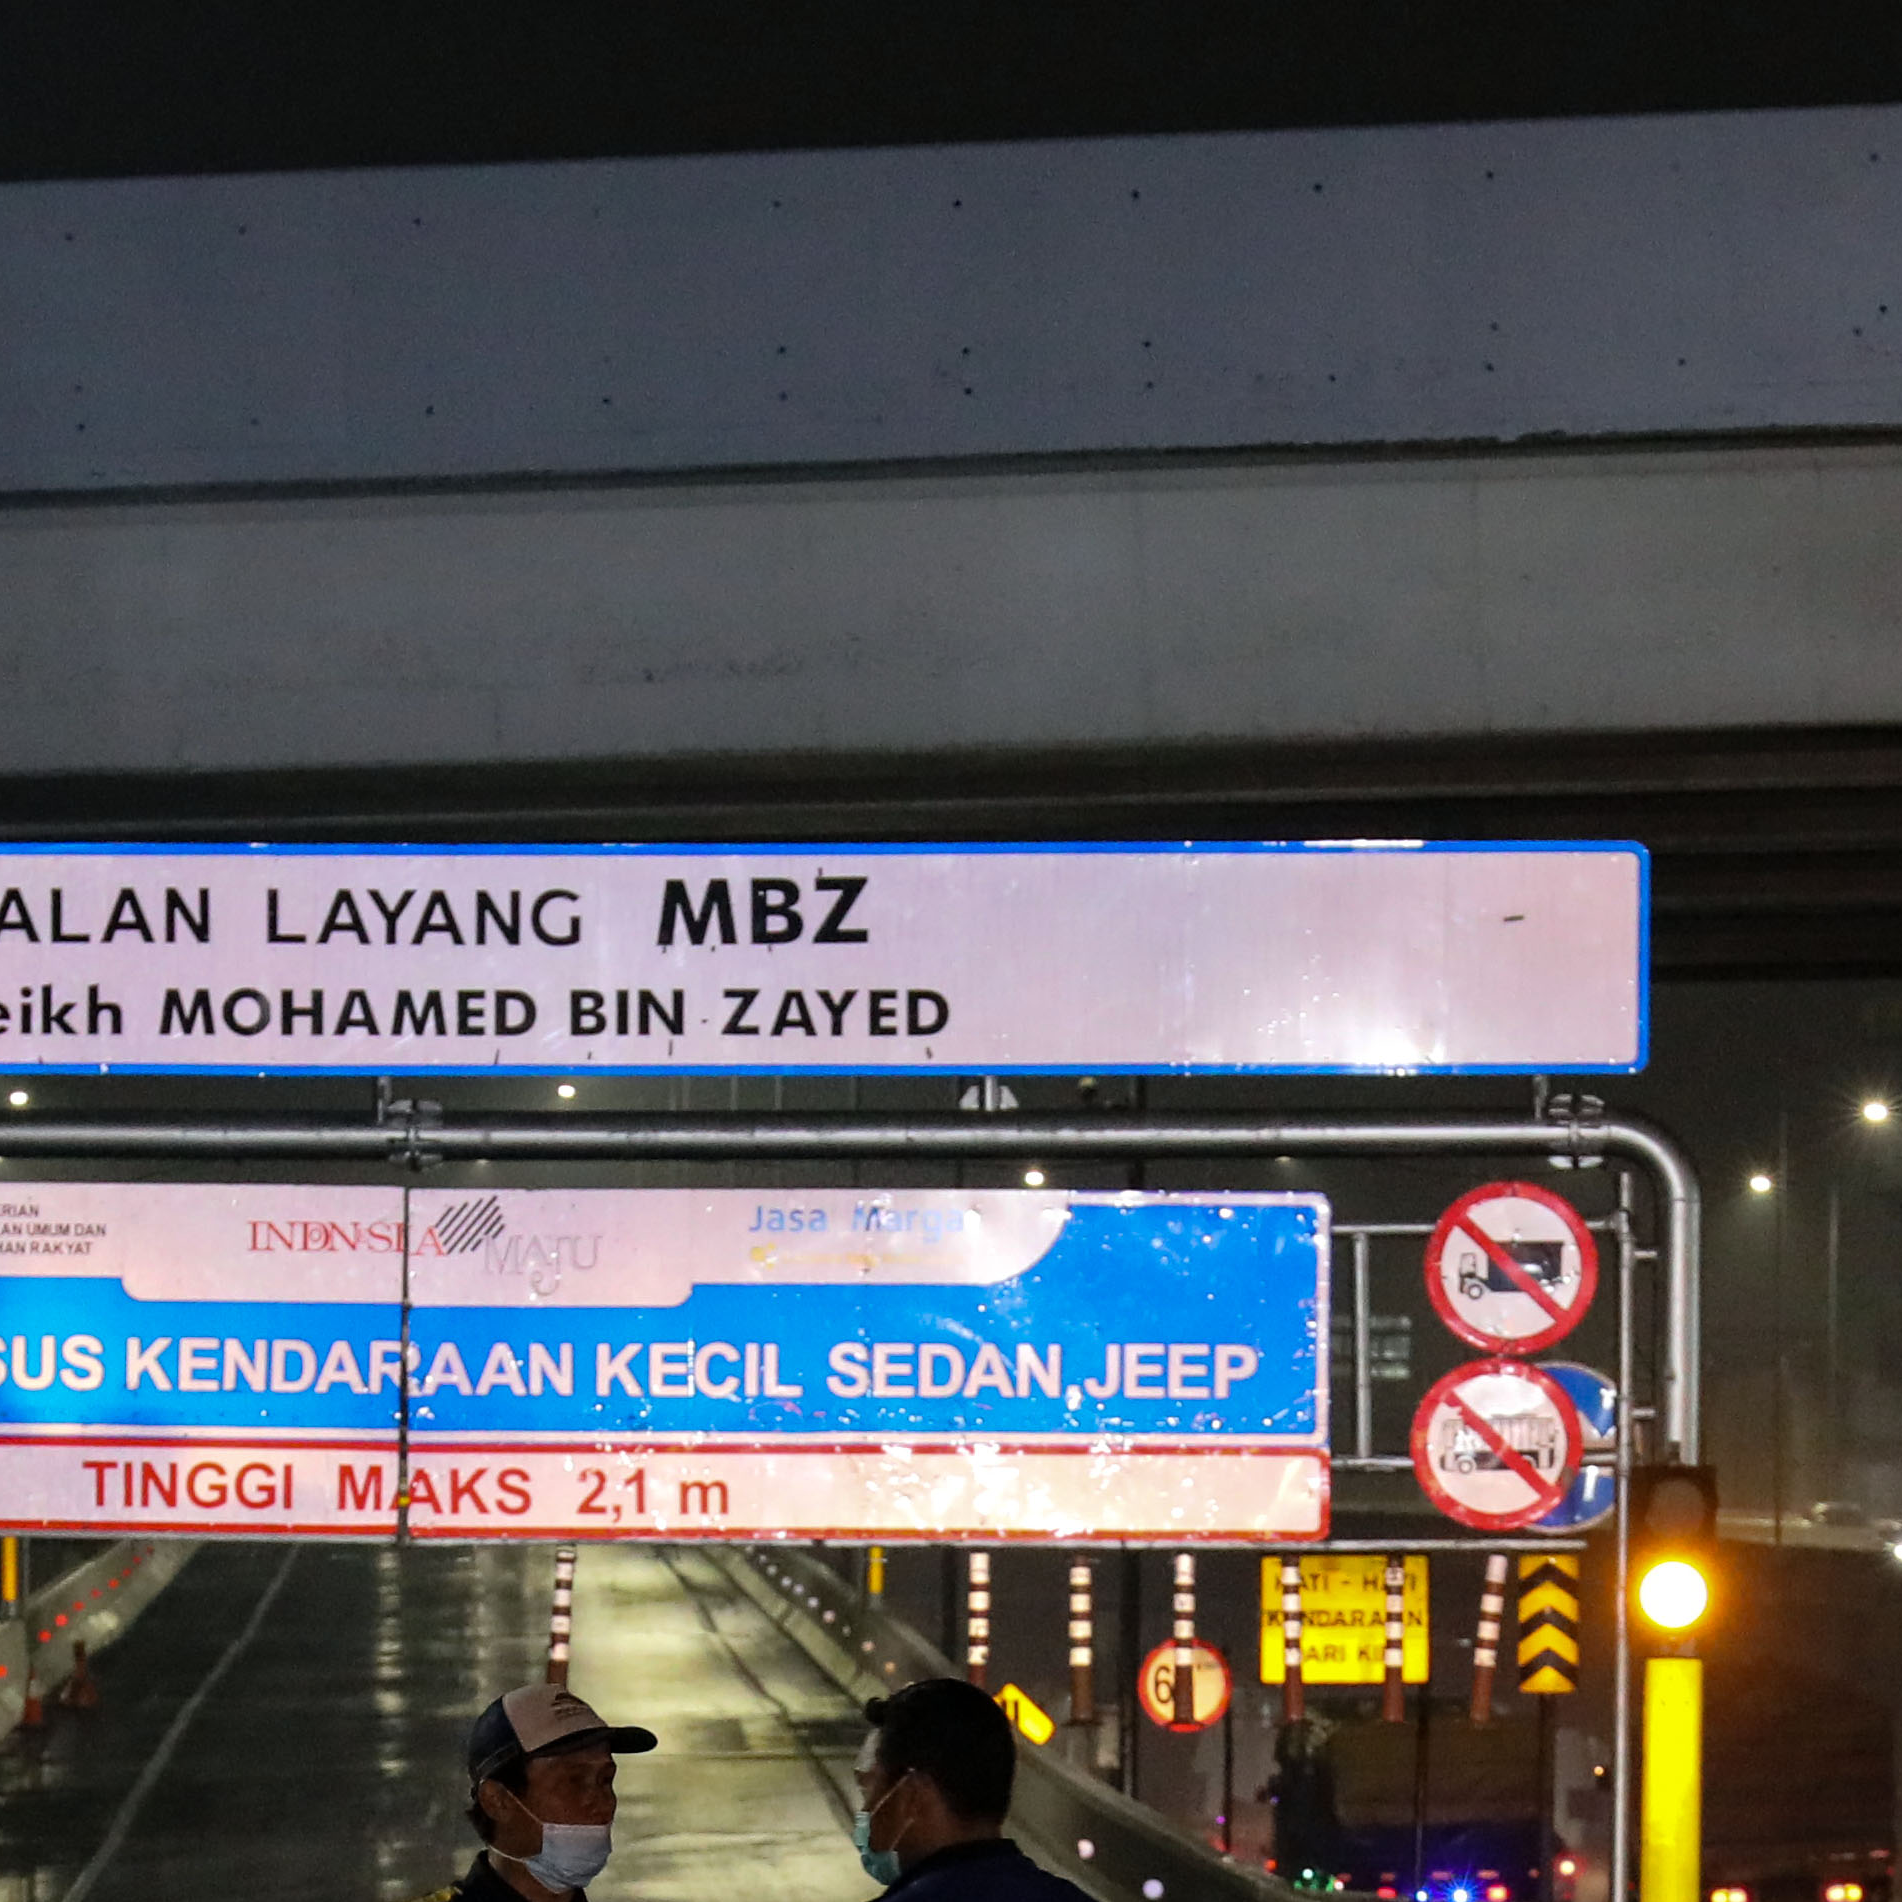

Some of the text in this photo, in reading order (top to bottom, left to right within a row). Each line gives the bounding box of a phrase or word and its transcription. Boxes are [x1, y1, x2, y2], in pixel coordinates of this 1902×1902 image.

[266, 888, 583, 947] LAYANG
[656, 878, 870, 947] MBZ
[158, 987, 538, 1037] MOHAMED
[569, 989, 686, 1037] BIN
[720, 988, 951, 1037] ZAYED
[26, 1222, 71, 1237] UMUM
[73, 1222, 107, 1237] DAN
[29, 1240, 94, 1255] RAKYAT
[749, 1205, 966, 1244] Jasa Marga
[125, 1337, 574, 1397] KENDARAAN
[596, 1340, 803, 1401] KECIL
[83, 1461, 729, 1524] TINGGI MAKS 2,1 m
